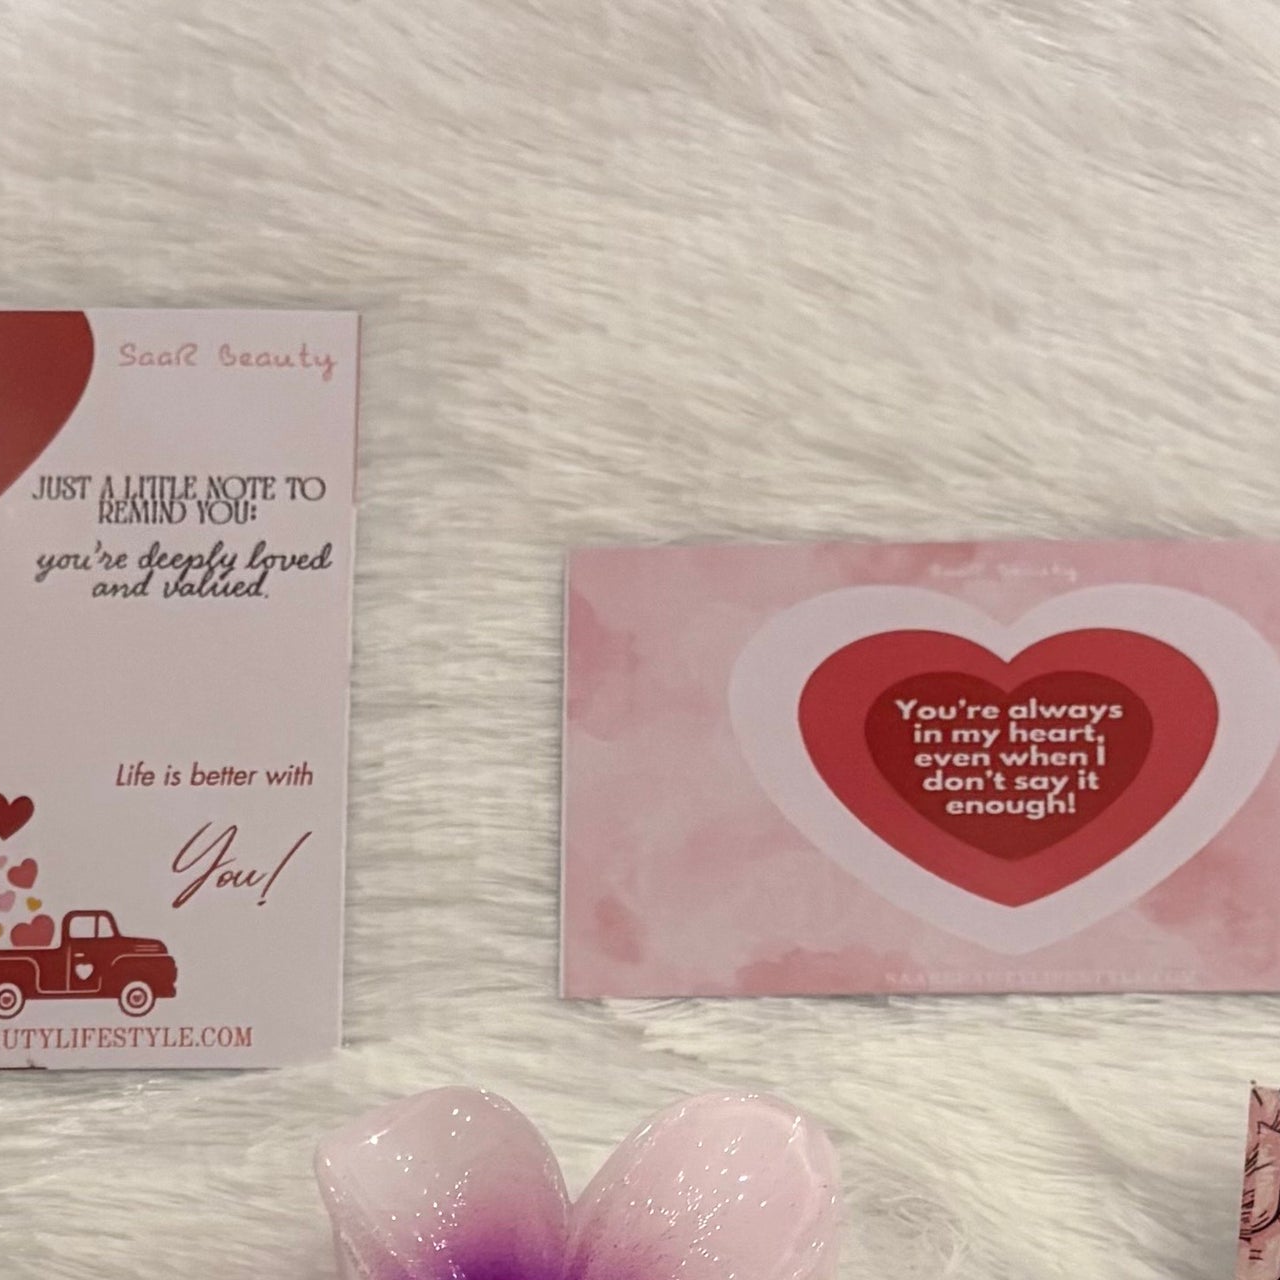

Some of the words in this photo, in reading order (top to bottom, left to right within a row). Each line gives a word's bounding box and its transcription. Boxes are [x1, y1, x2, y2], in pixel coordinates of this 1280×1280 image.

[119, 343, 199, 367] SaaR
[219, 344, 338, 381] Beauty
[32, 476, 91, 500] JUST
[99, 476, 120, 500] A
[122, 476, 198, 500] LITTLE
[206, 476, 276, 500] NOTE
[286, 476, 326, 500] TO
[98, 500, 186, 525] REMIND
[197, 501, 257, 525] YOU:
[35, 541, 127, 582] you're
[138, 541, 237, 580] deeply
[244, 541, 332, 571] loved
[92, 575, 149, 599] and
[162, 574, 270, 600] valued.
[895, 698, 1000, 721] You're
[1008, 698, 1123, 724] always
[913, 723, 942, 743] in
[951, 727, 1000, 748] my
[1009, 721, 1104, 744] heart,
[914, 750, 990, 767] even
[1000, 745, 1088, 767] when
[1097, 745, 1106, 766] I
[116, 762, 154, 787] Life
[164, 763, 181, 787] is
[190, 762, 257, 787] better
[266, 762, 313, 787] with
[922, 770, 1006, 791] don't
[1015, 775, 1068, 796] say
[1077, 770, 1099, 790] it
[946, 793, 1076, 820] enough!
[171, 821, 312, 909] You!
